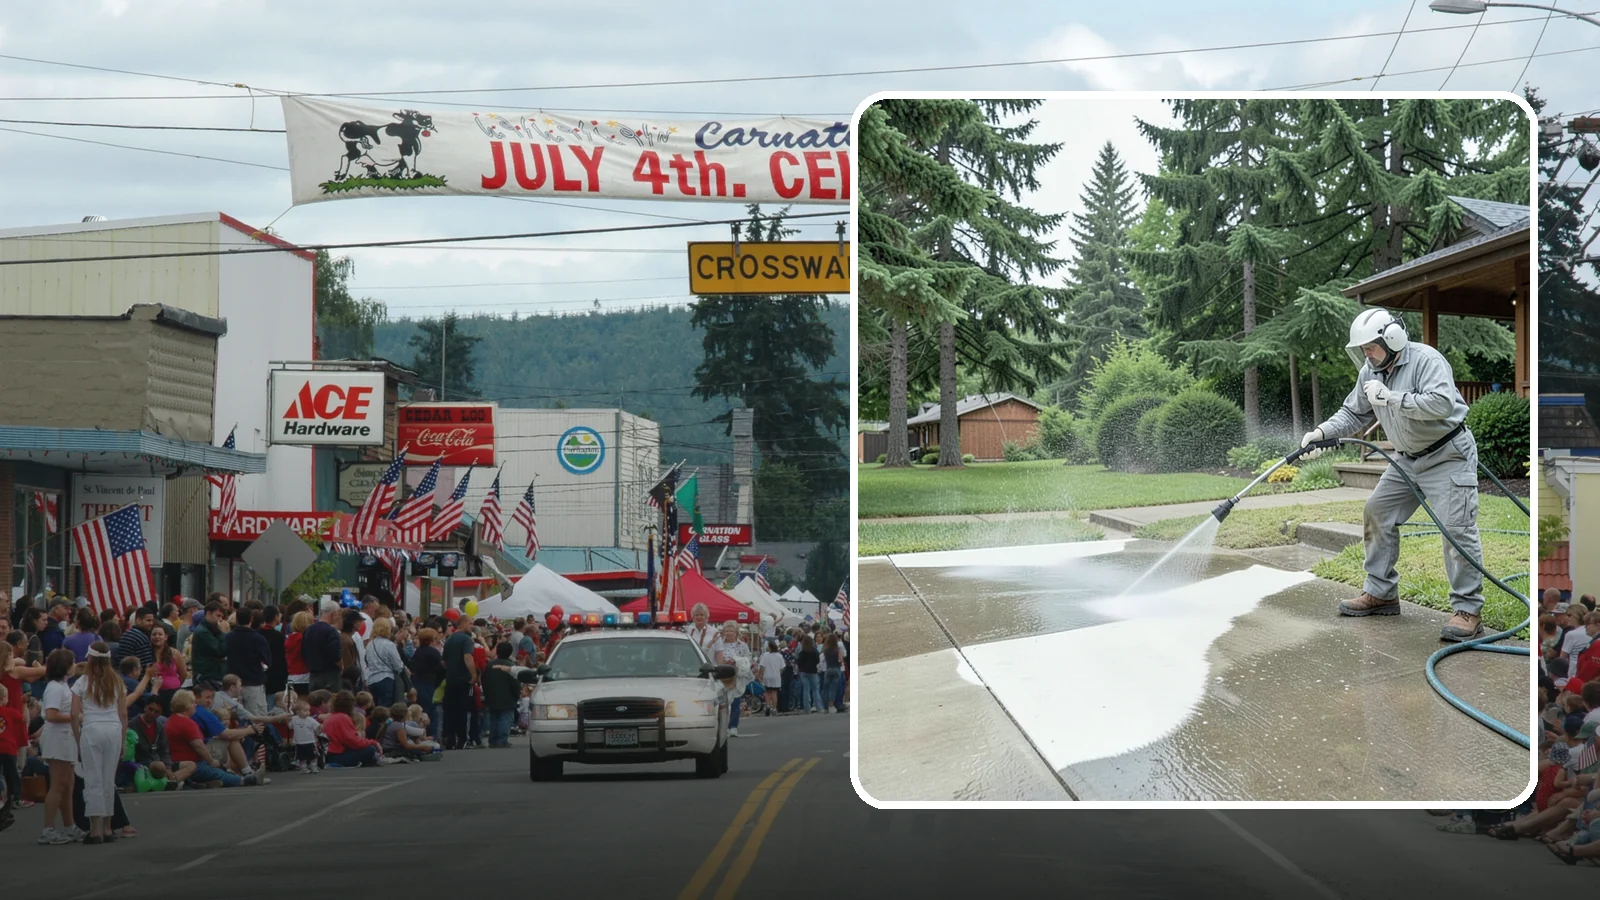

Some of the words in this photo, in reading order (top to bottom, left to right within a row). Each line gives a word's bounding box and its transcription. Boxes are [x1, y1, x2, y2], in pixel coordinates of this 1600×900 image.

[481, 141, 605, 193] JULY
[632, 150, 746, 197] 4th.
[282, 380, 373, 420] ACE
[406, 409, 452, 421] CEDAR
[283, 421, 370, 436] Hardware
[416, 428, 477, 447] Coca-Cola
[83, 485, 93, 494] St.
[95, 485, 124, 494] Vincent
[126, 486, 136, 494] de
[137, 486, 155, 495] Paul
[699, 535, 730, 543] GLASS
